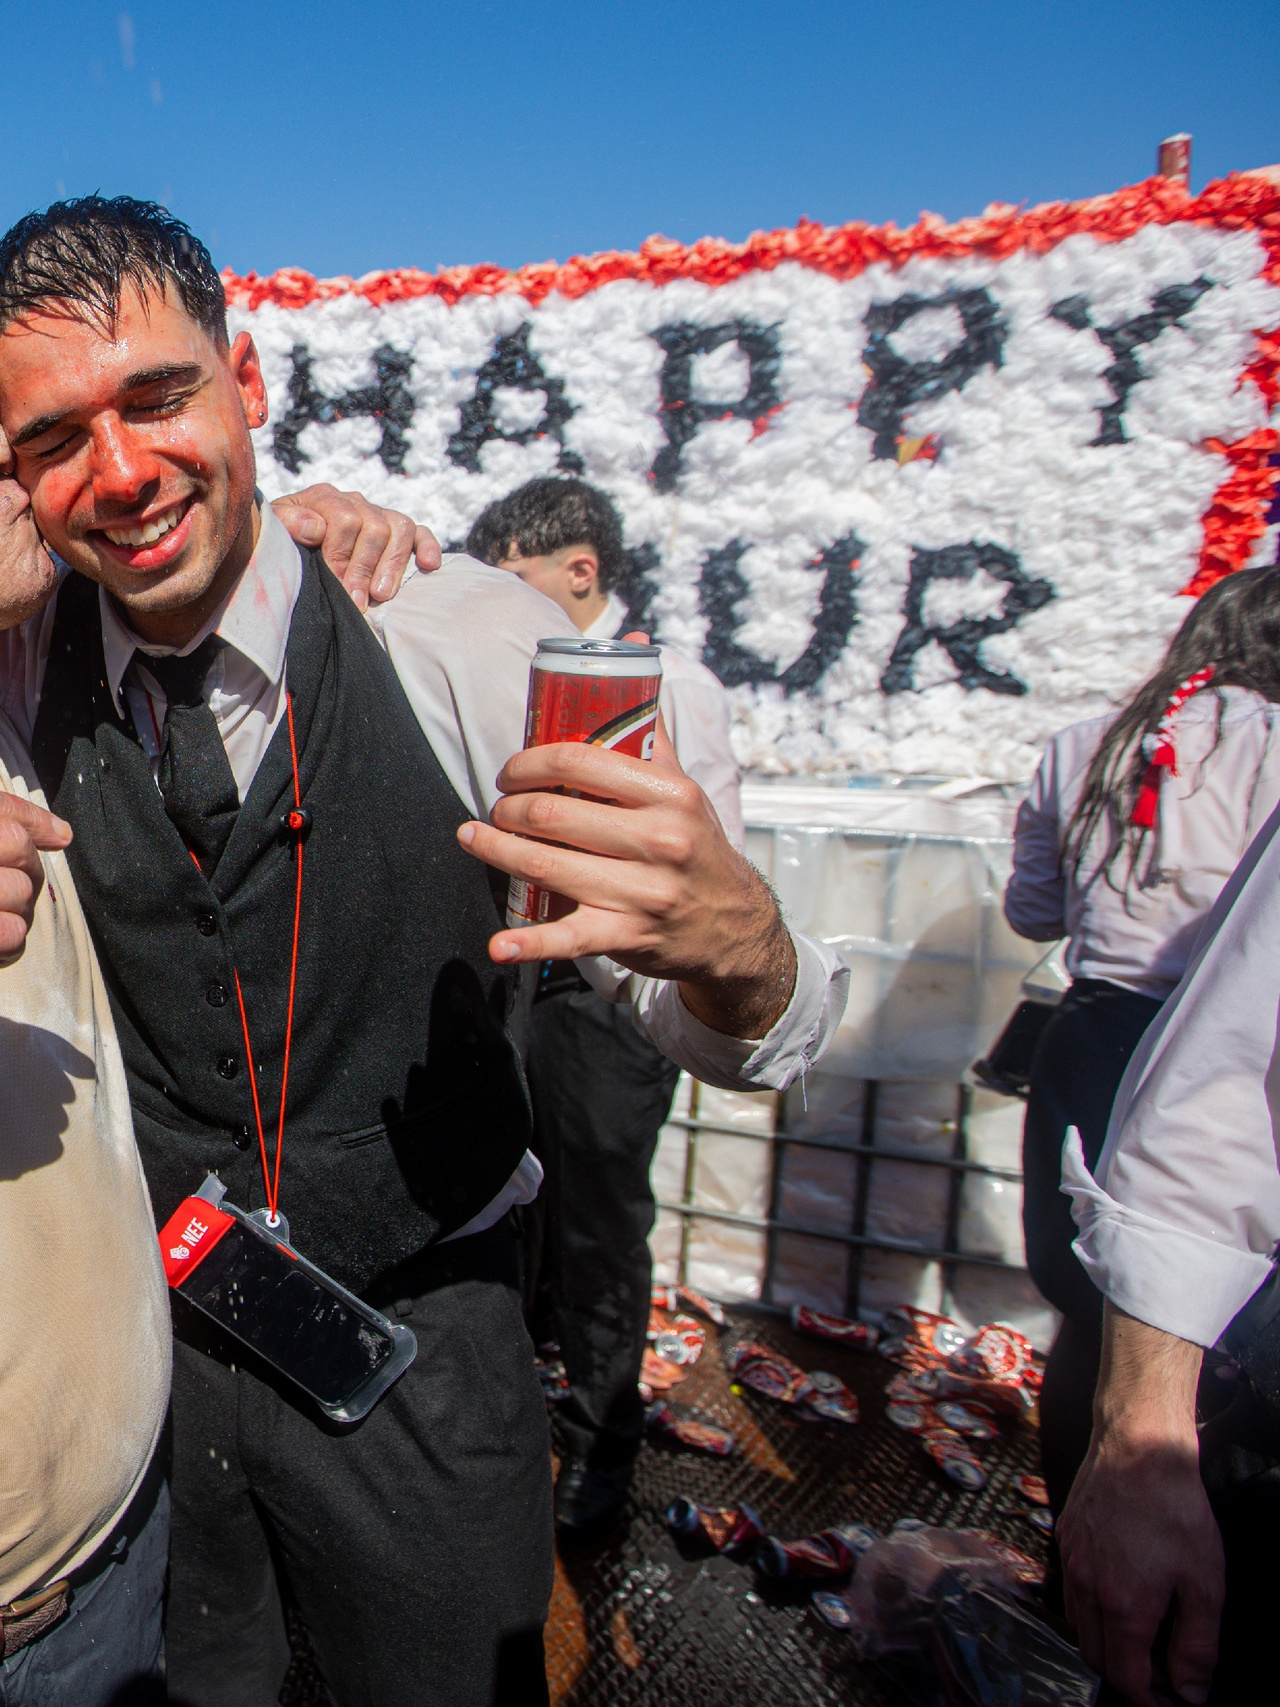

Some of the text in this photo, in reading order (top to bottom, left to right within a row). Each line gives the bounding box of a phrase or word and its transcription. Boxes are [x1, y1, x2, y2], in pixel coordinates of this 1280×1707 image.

[273, 276, 1213, 491] HAPPY
[618, 528, 1057, 697] UR
[181, 1217, 209, 1247] NEE
